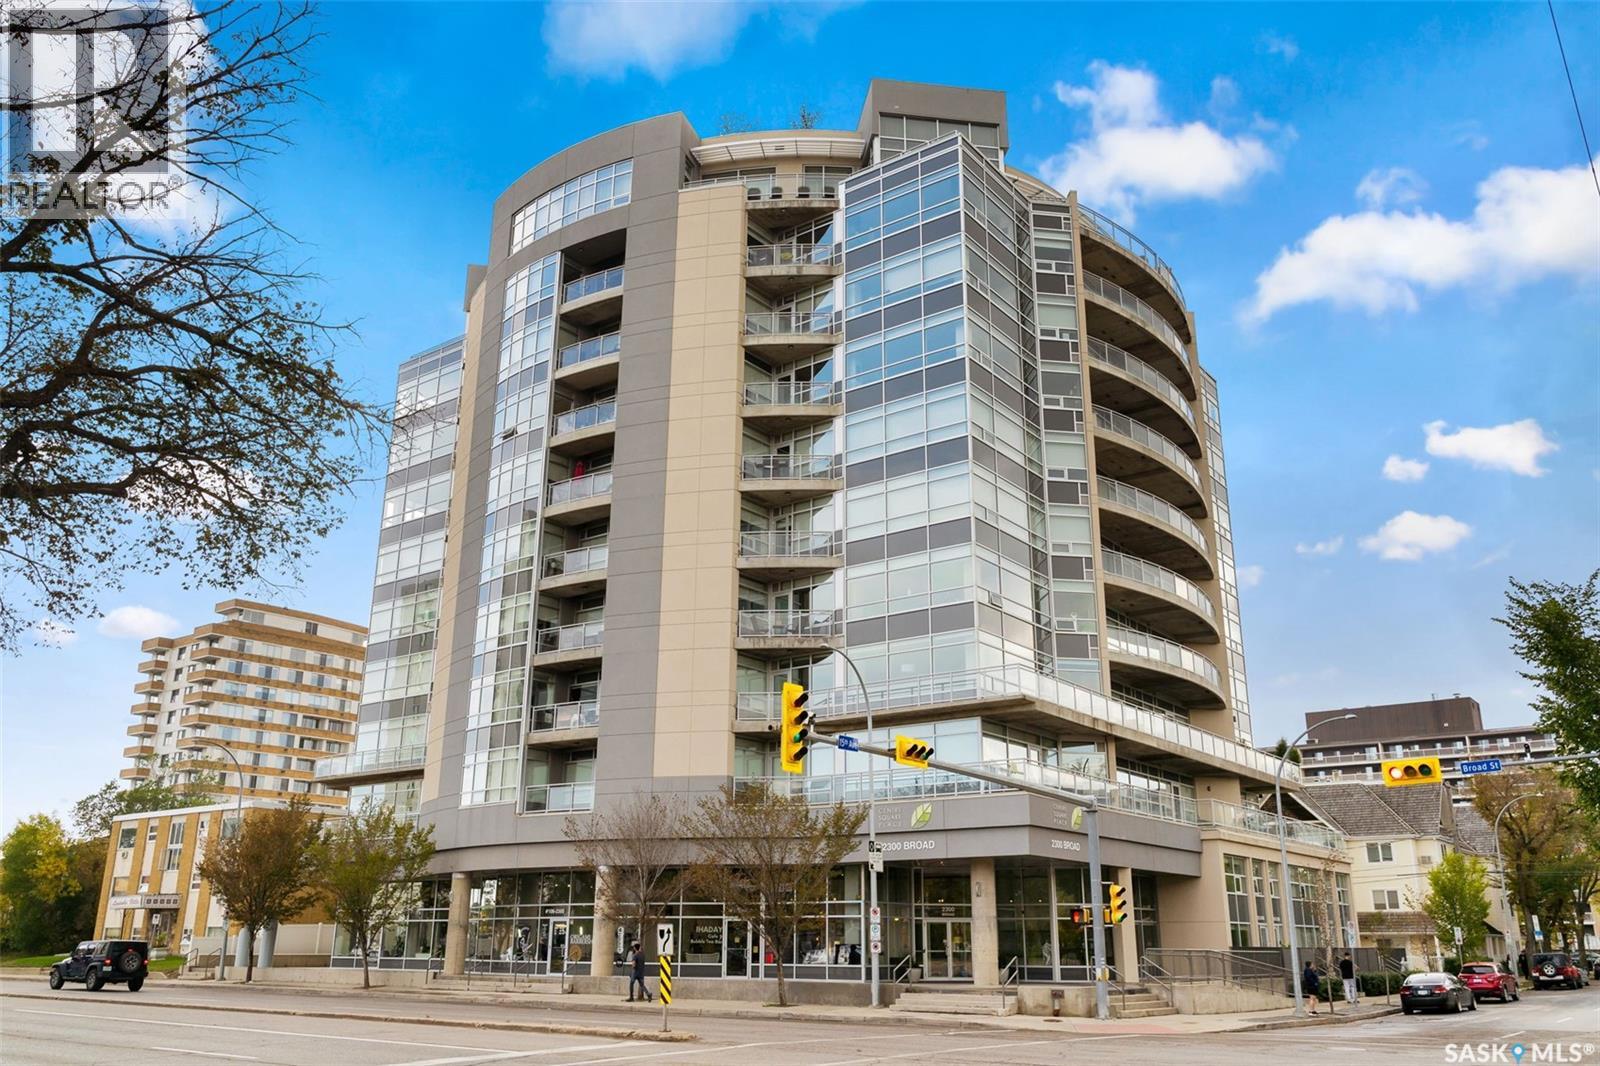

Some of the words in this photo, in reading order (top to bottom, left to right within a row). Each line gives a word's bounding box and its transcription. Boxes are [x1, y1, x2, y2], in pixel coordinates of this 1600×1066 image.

[1462, 763, 1488, 773] Broad
[1489, 761, 1500, 770] St
[882, 841, 902, 851] 2300
[903, 840, 936, 850] BROAD
[1051, 839, 1063, 849] 2300
[1063, 840, 1081, 852] BROAD
